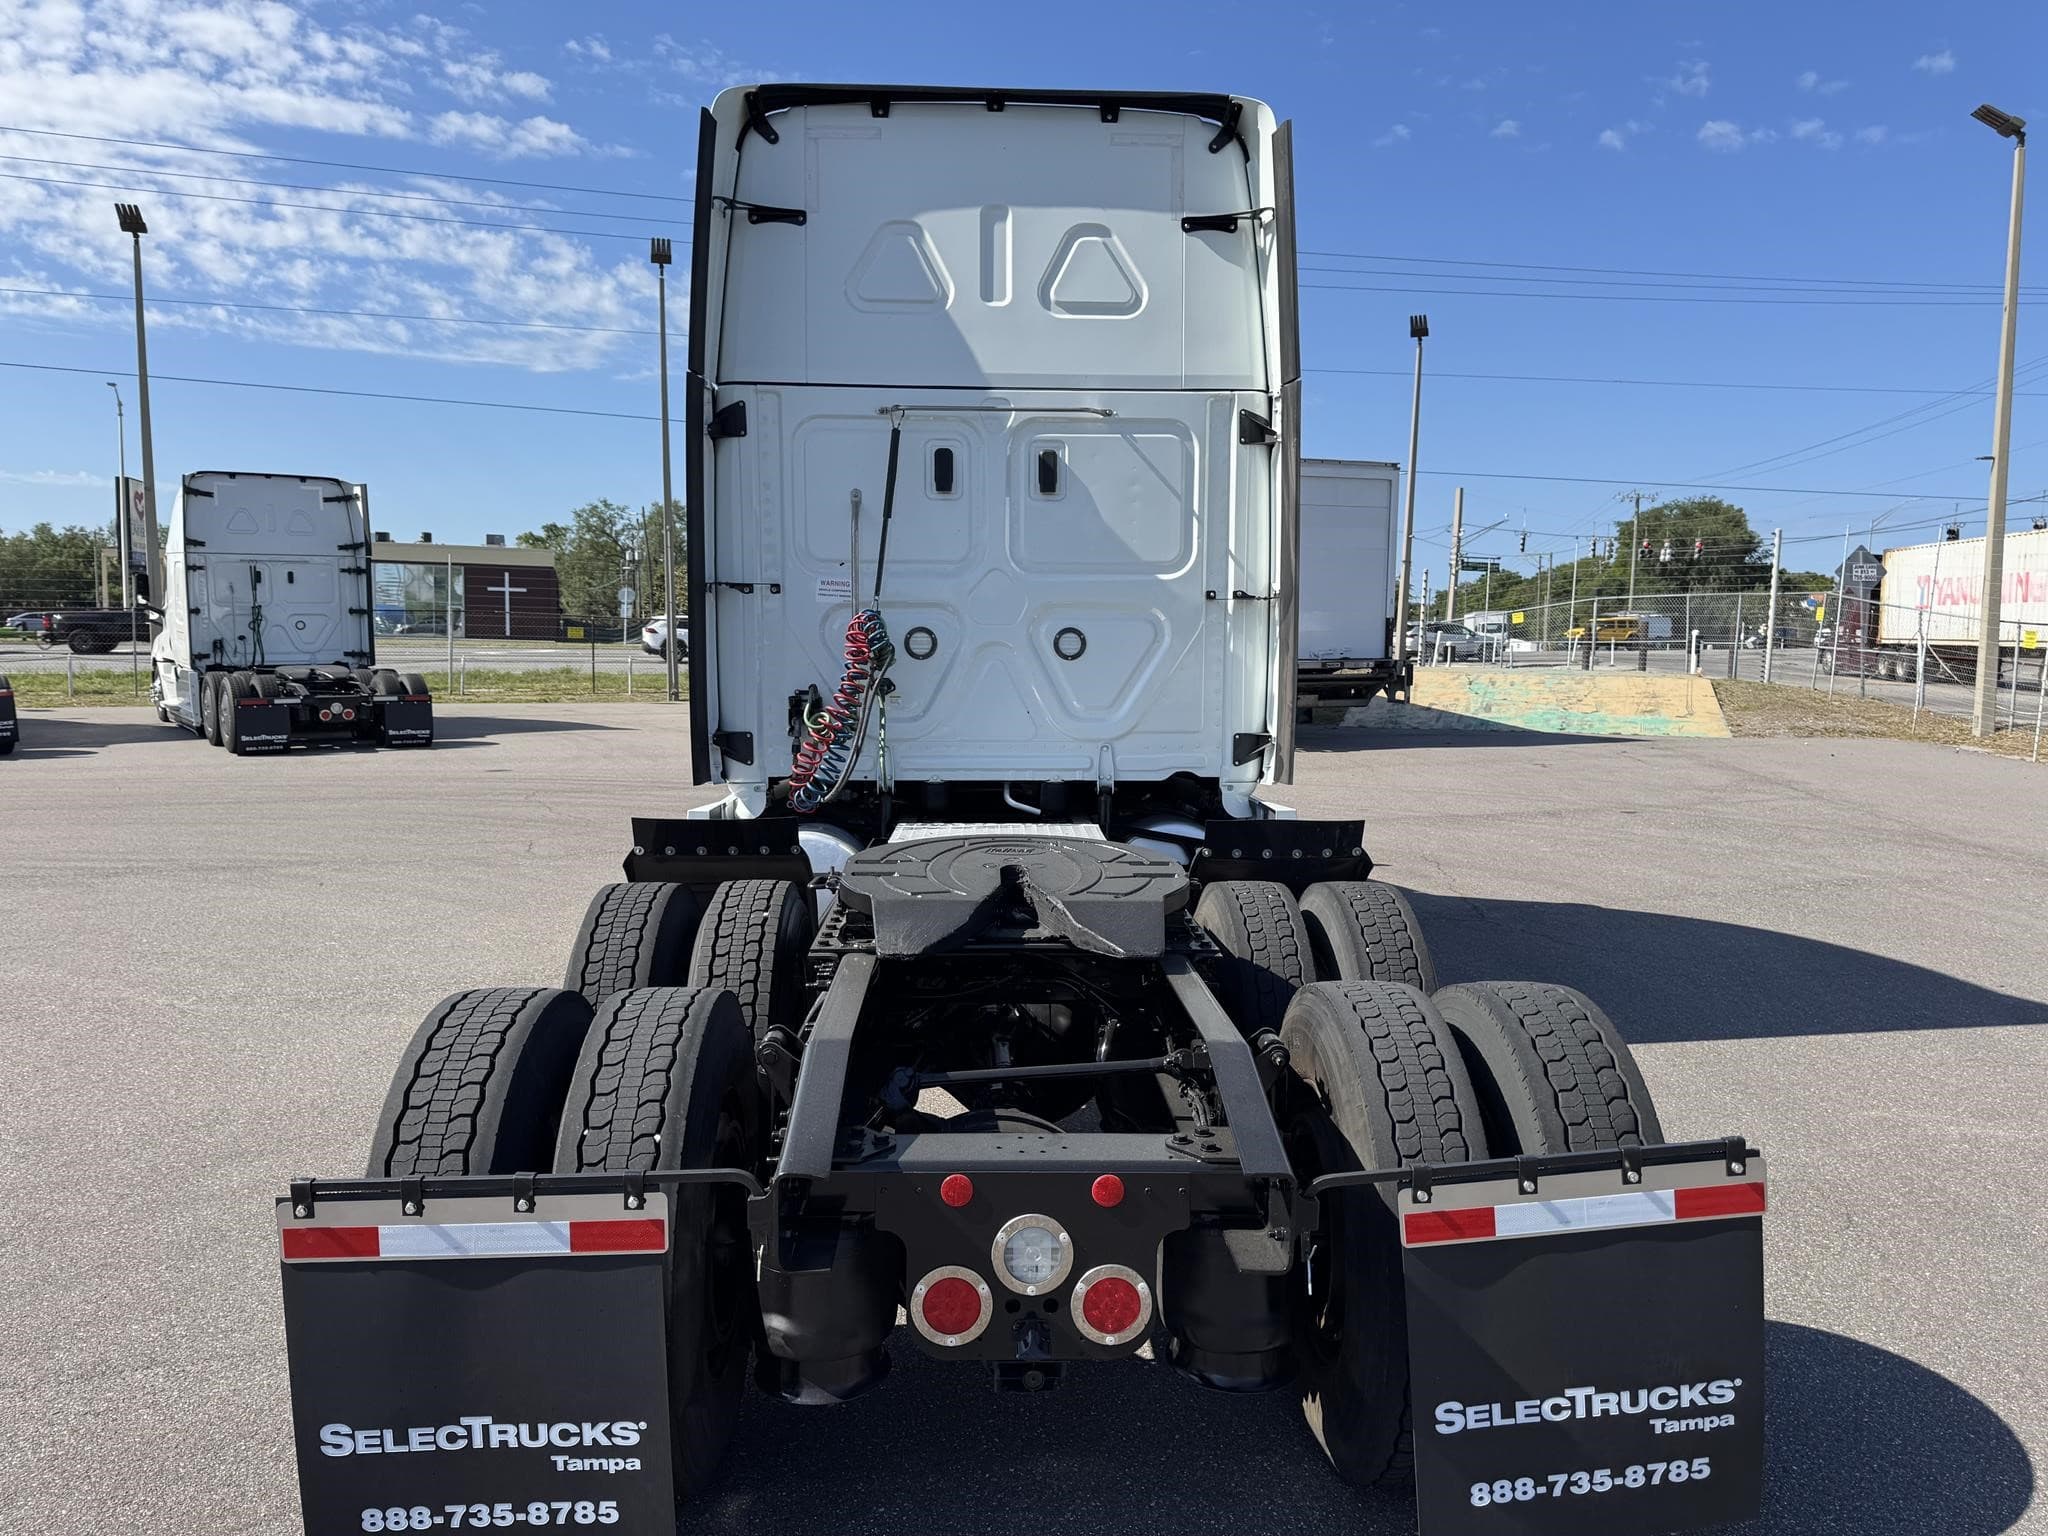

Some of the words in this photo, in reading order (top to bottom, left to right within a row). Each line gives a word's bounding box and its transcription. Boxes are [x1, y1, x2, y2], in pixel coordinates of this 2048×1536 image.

[1649, 1414, 1735, 1435] Tampa
[550, 1455, 642, 1474] Tampa
[1470, 1457, 1711, 1507] 888-735-8785
[361, 1501, 620, 1533] 888-735-8785
